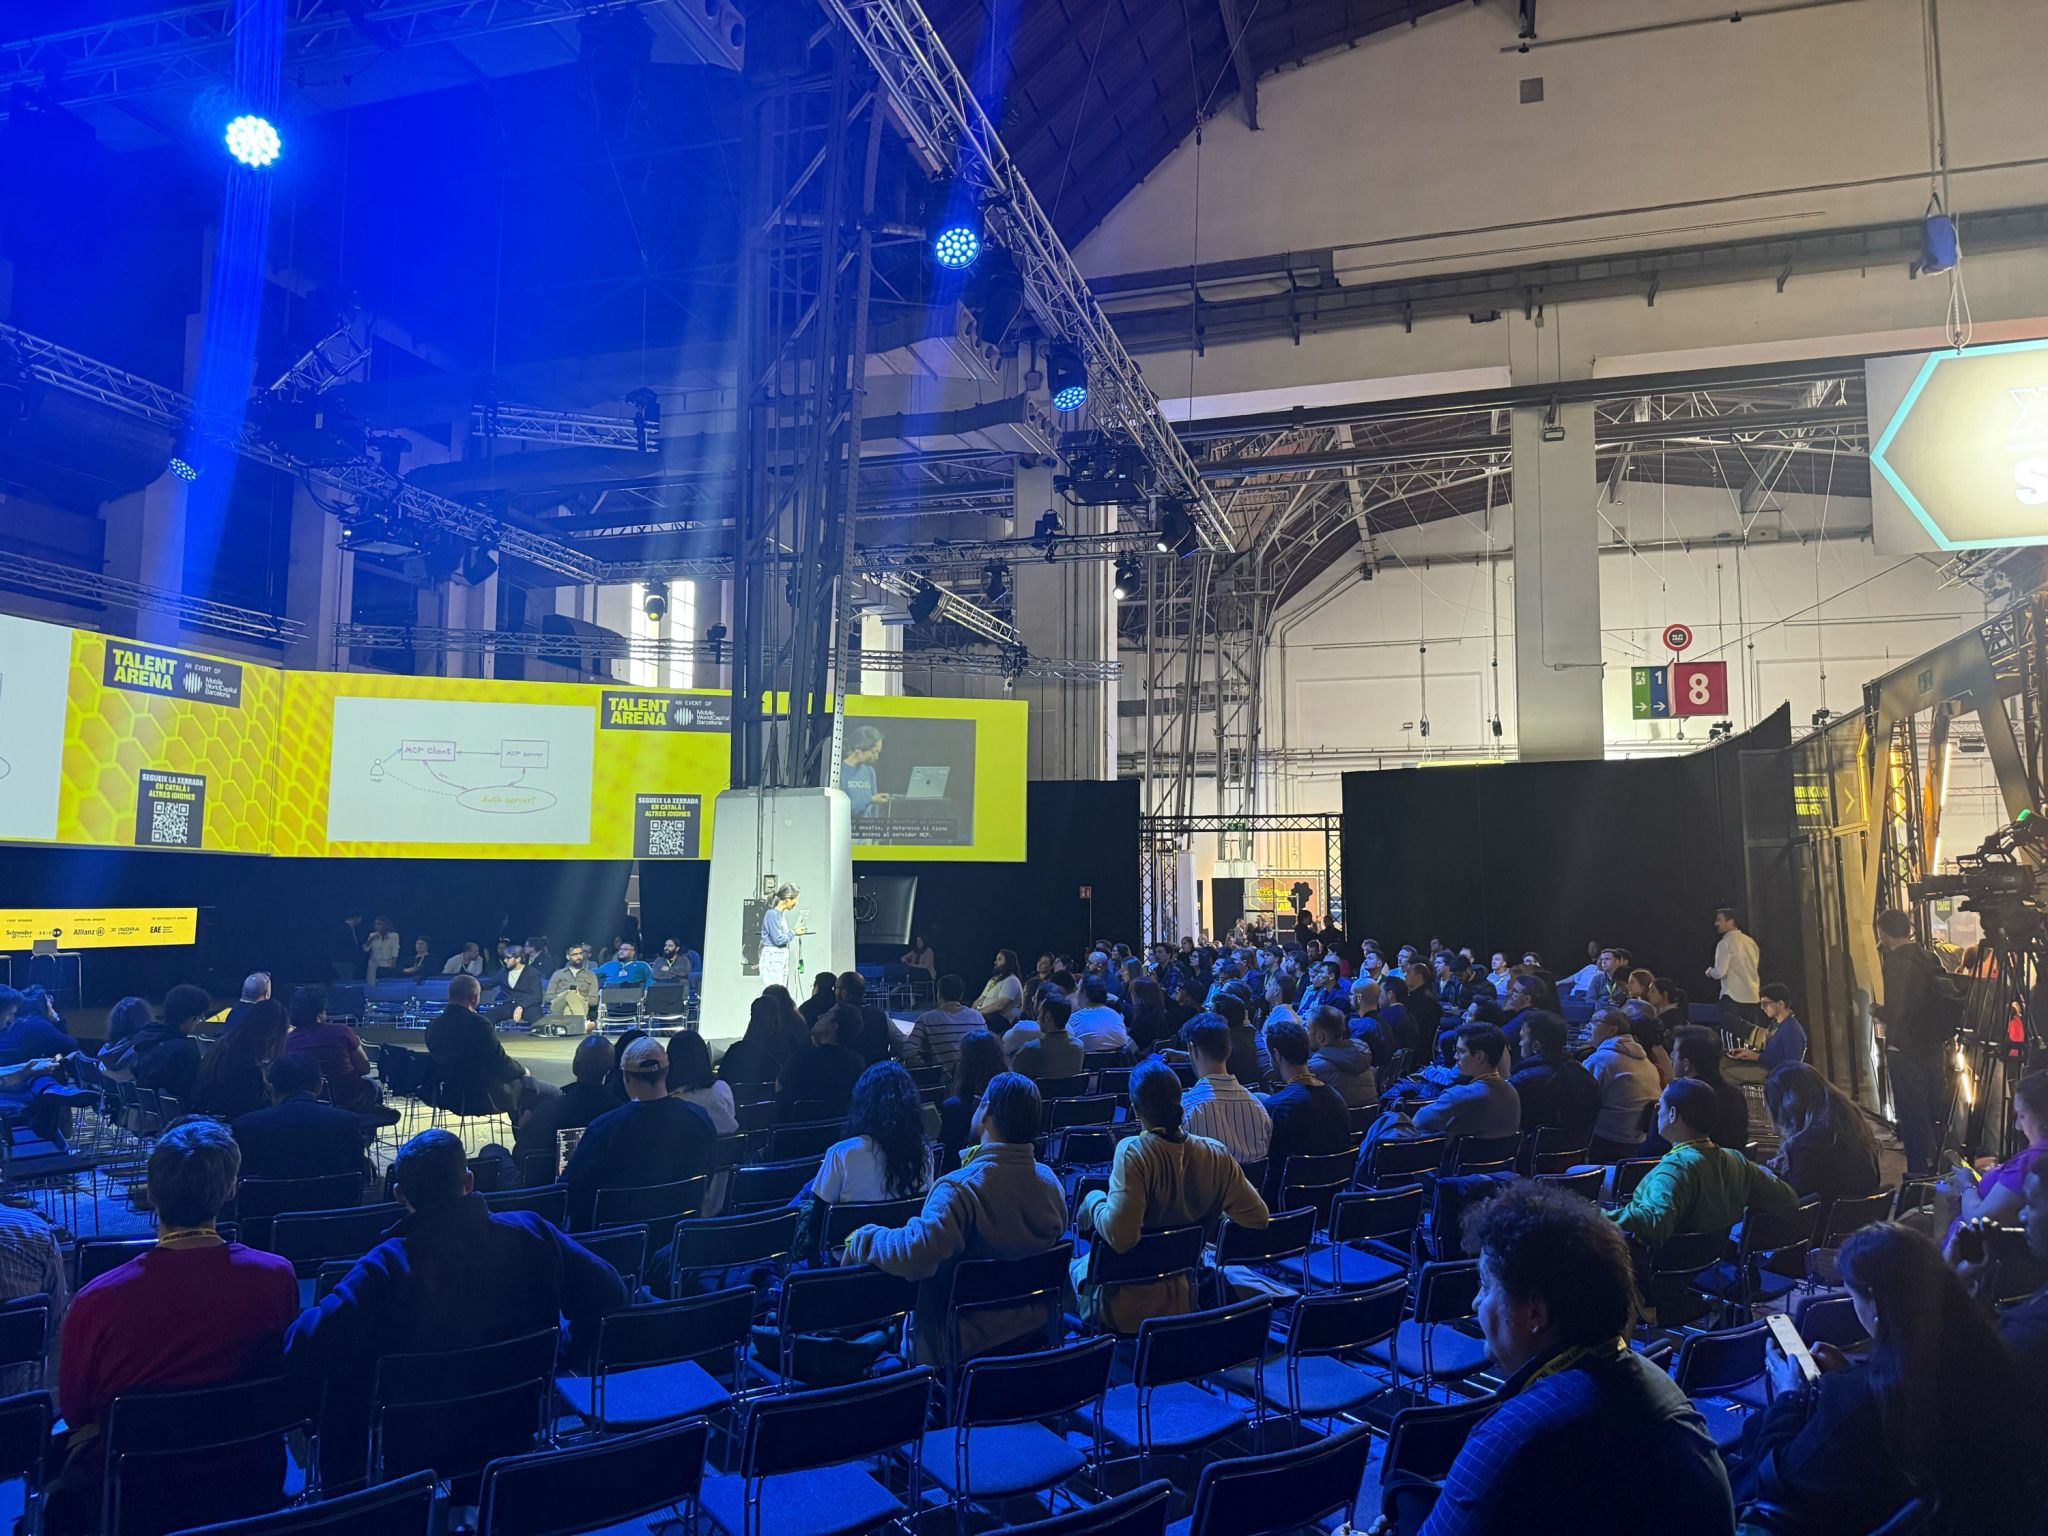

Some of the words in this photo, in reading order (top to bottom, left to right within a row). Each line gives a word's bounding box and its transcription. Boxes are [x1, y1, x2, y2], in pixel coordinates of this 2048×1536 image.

[113, 648, 177, 675] TALENT
[194, 664, 212, 672] EVENT
[114, 666, 173, 690] ARENA
[205, 676, 223, 685] Mobile
[1655, 671, 1662, 684] 1
[205, 689, 230, 698] Barcelona
[1688, 672, 1710, 705] 8
[608, 697, 670, 712] TALENT
[610, 711, 666, 725] ARENA
[405, 746, 424, 754] MCP
[142, 774, 168, 783] SEGUEIX
[177, 777, 204, 786] XERRADA
[149, 790, 170, 798] ALTRES
[171, 792, 195, 800] IDIOMES
